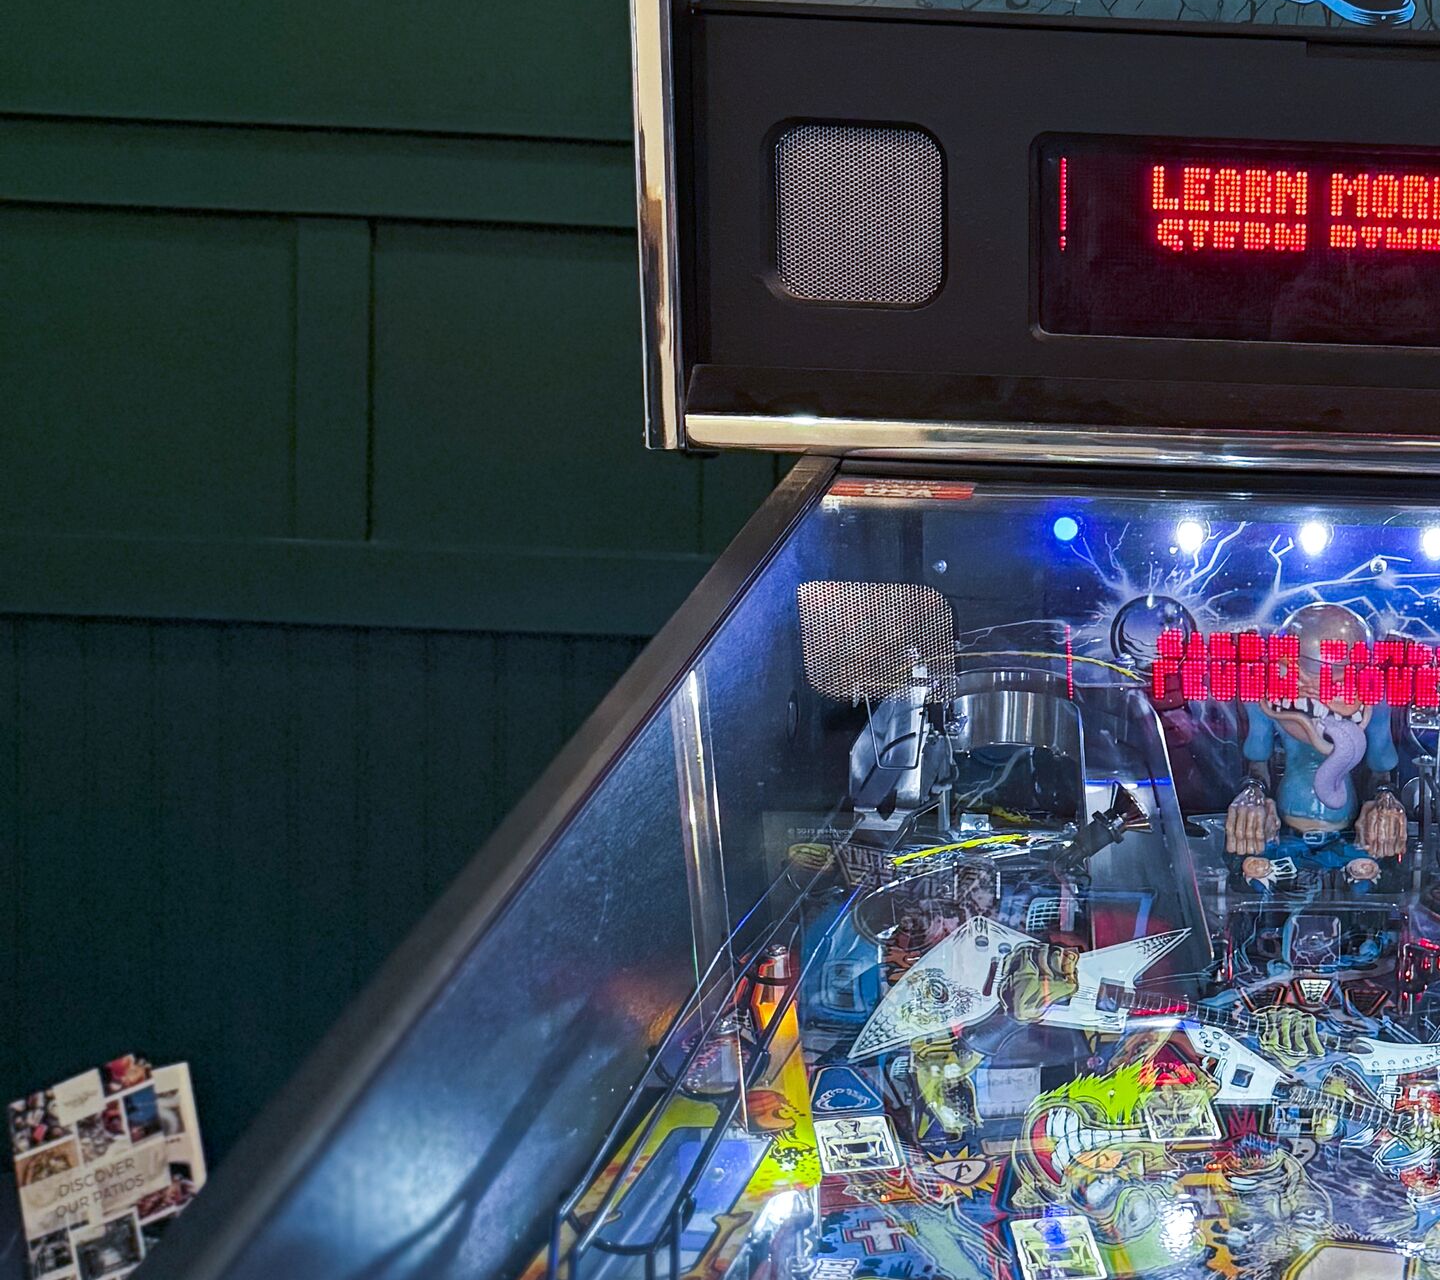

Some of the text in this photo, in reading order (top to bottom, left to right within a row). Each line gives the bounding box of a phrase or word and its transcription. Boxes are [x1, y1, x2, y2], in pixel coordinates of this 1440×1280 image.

[1152, 165, 1308, 215] LEARN
[55, 1173, 145, 1219] OUR PATIOS
[57, 1157, 136, 1198] DISCOVER
